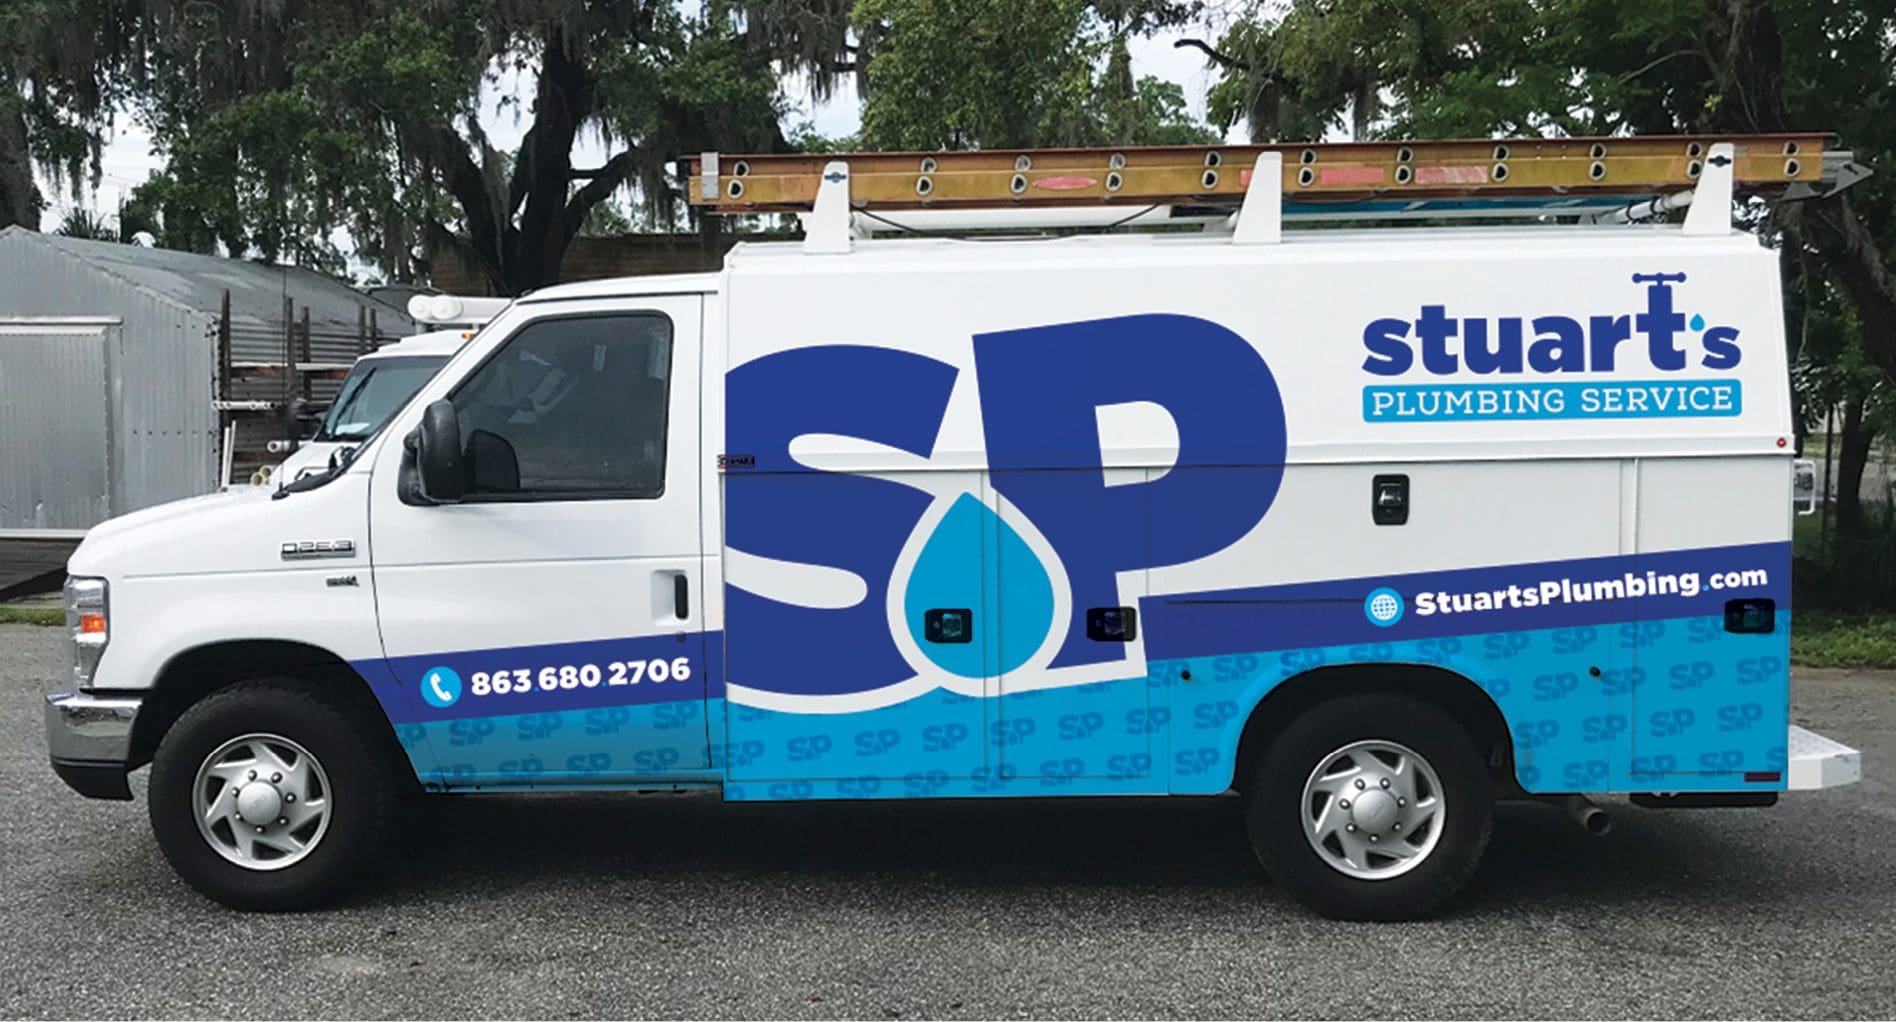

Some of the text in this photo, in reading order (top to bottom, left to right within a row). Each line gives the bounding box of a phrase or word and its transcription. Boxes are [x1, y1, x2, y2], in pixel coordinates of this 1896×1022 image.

[1372, 385, 1733, 417] PLUMBING SERVICE
[1415, 565, 1769, 616] StuartsPlumbing.com
[471, 657, 691, 696] 863.680.2706
